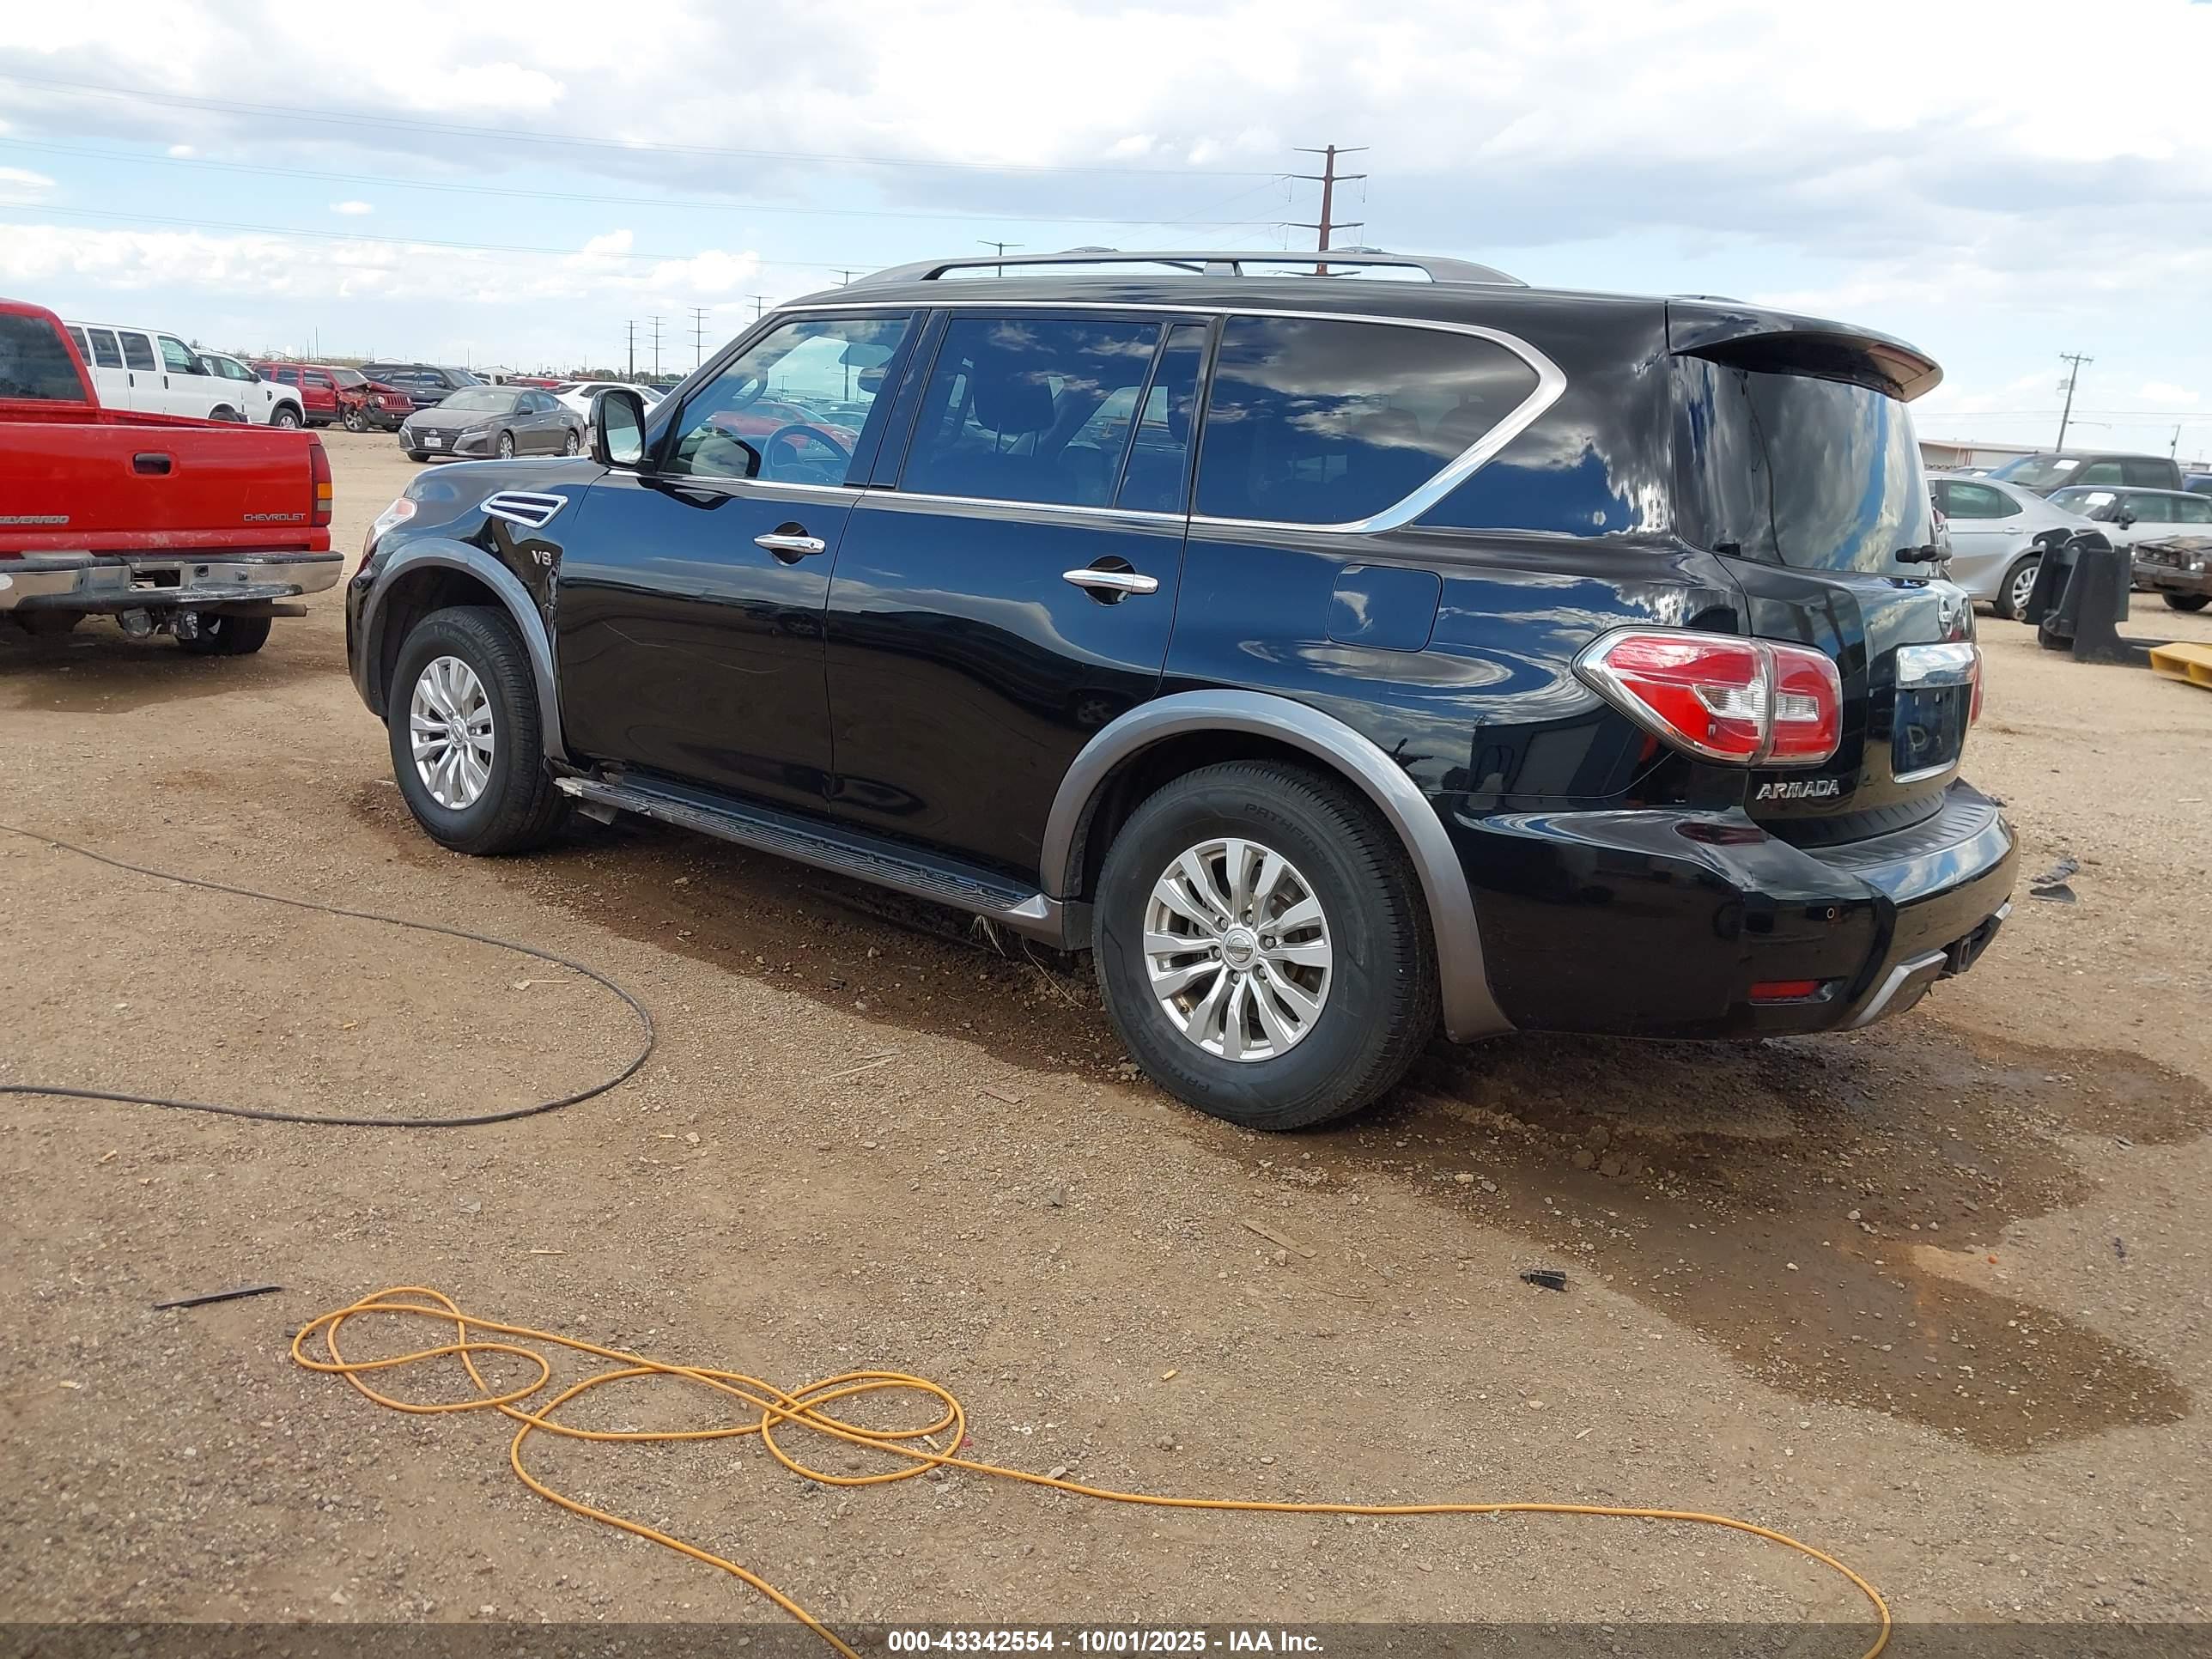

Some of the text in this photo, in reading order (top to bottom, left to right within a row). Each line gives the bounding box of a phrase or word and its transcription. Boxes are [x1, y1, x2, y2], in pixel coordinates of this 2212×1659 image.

[243, 513, 307, 522] CHEVROLET
[531, 550, 552, 567] V8
[1755, 778, 1840, 800] ARMADA
